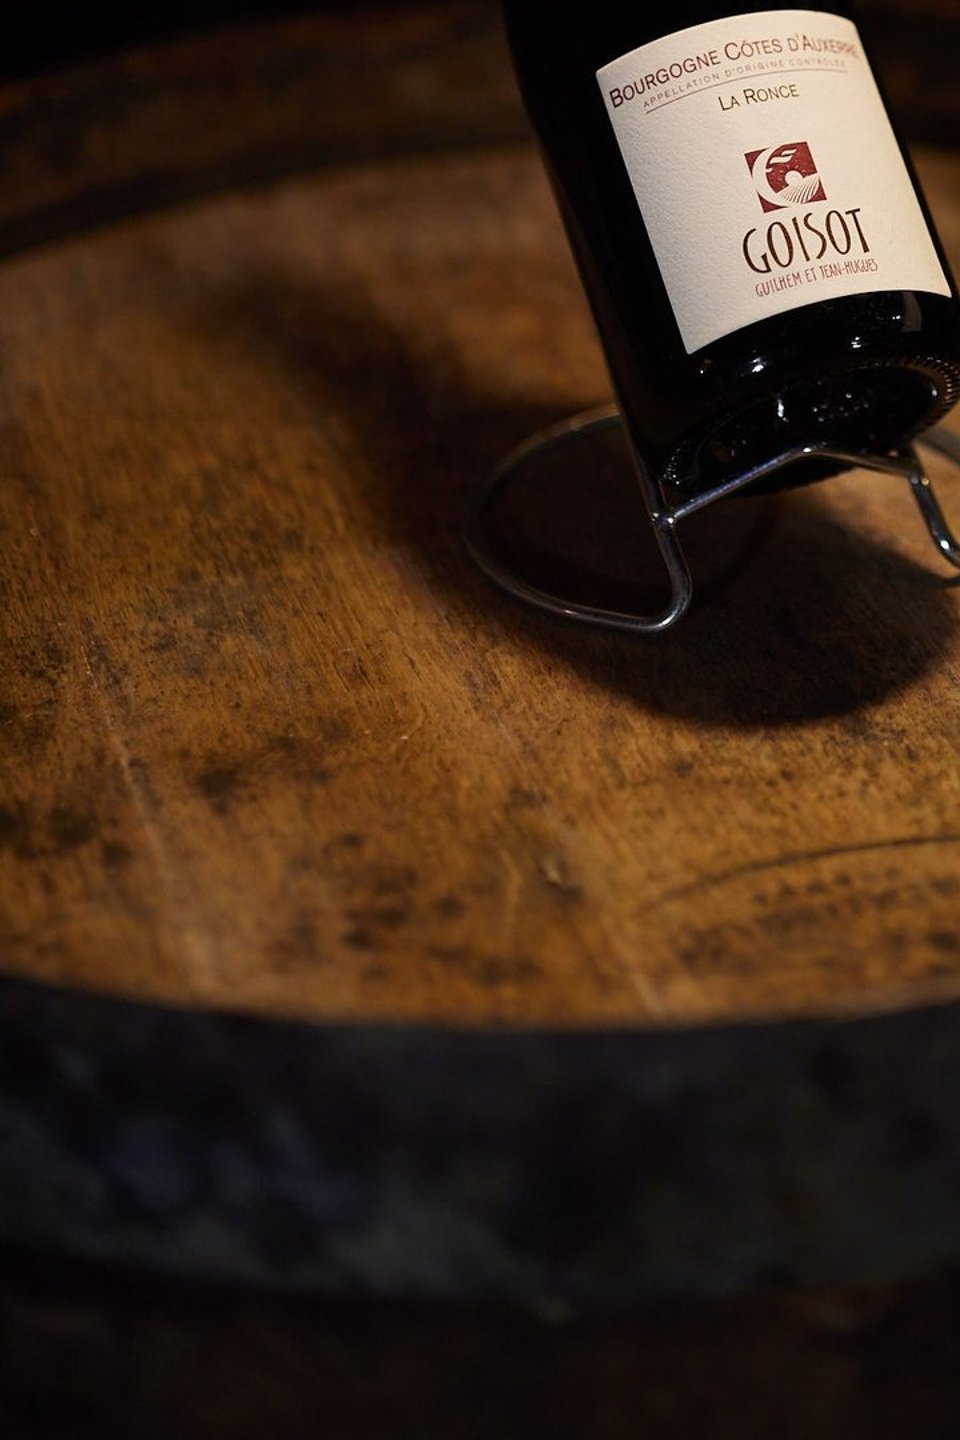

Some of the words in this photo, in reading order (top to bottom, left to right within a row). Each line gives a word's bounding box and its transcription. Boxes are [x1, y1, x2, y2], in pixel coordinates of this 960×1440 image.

[609, 50, 720, 108] BOURGOGNE
[724, 39, 782, 61] CÔTES
[642, 72, 720, 108] APPELLATION
[718, 94, 740, 111] LA
[743, 83, 799, 104] RONCE
[742, 208, 870, 274] GOISOT
[755, 270, 804, 297] GUILHEM
[804, 268, 818, 283] ET
[820, 258, 879, 280] JEAN-HUGUES
